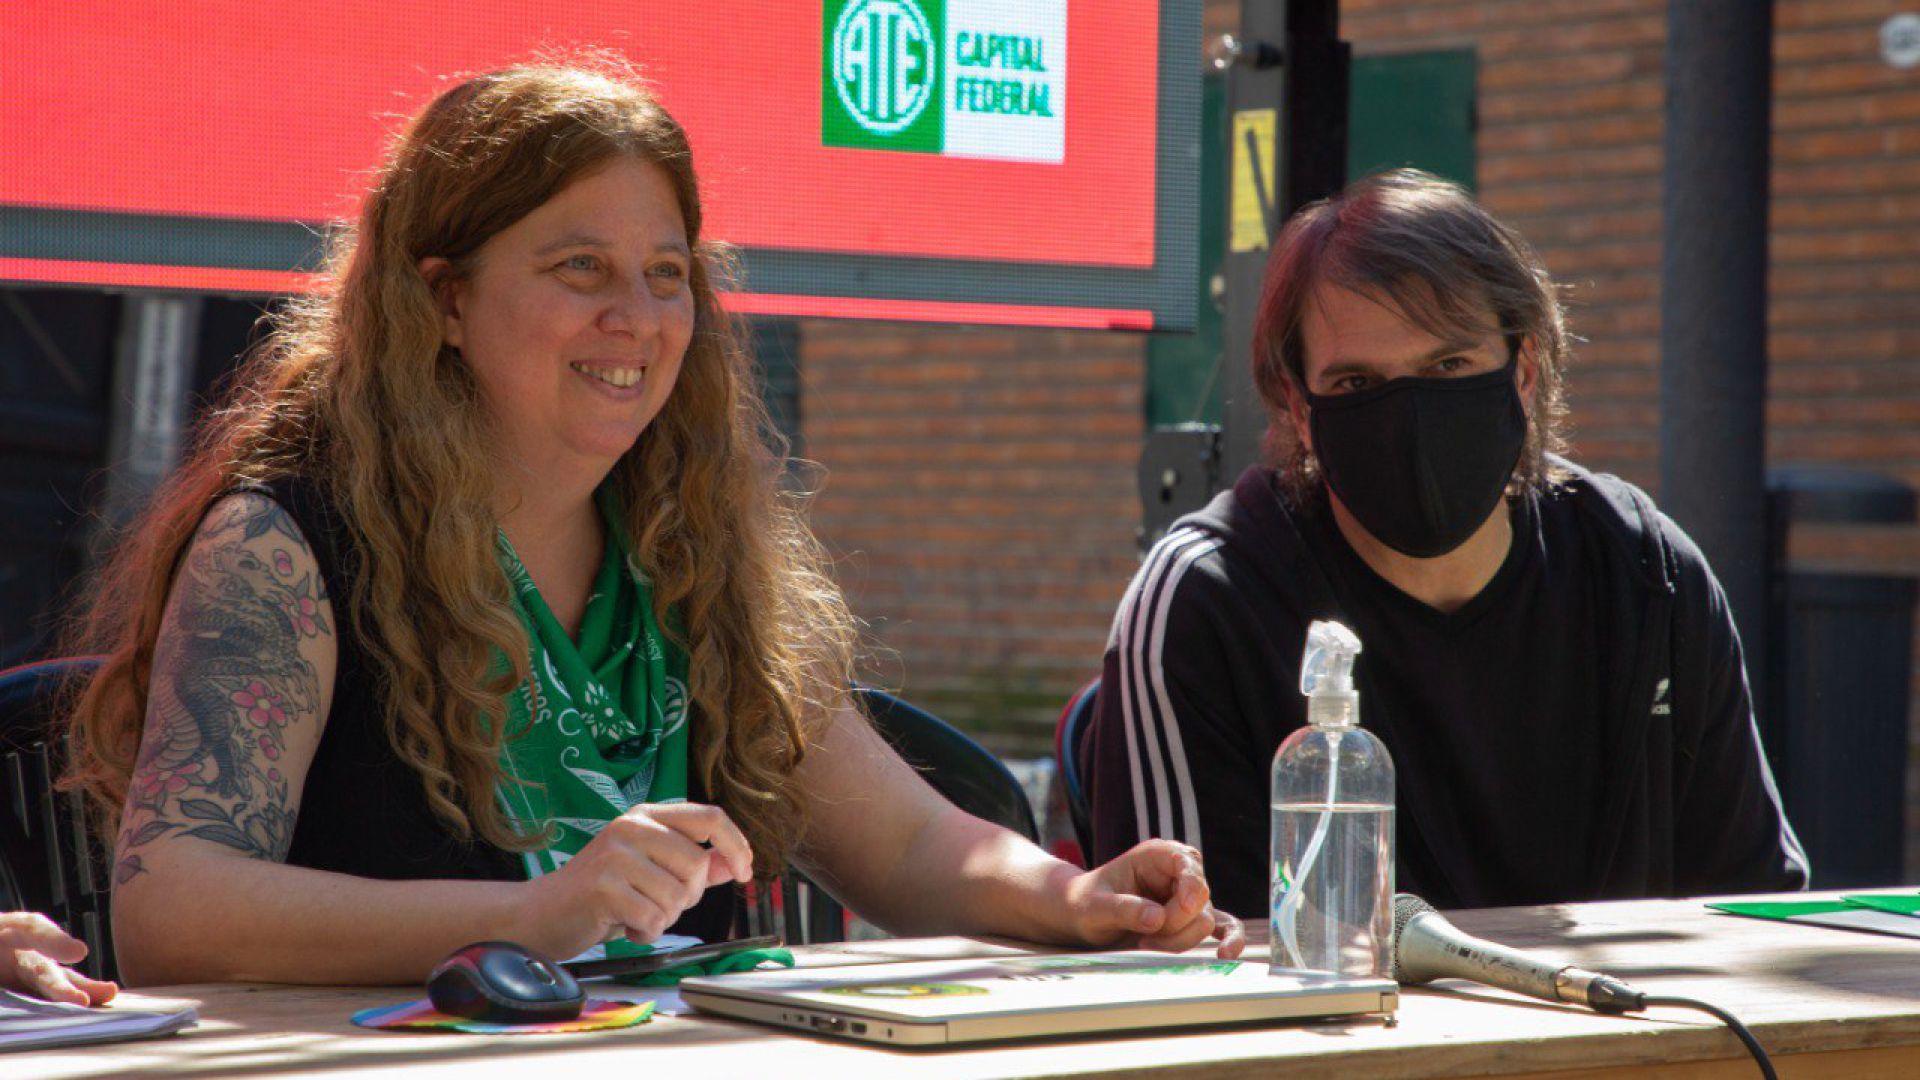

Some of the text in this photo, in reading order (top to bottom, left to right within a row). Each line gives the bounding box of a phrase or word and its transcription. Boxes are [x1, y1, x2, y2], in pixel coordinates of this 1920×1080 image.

[843, 1, 923, 119] ATE
[957, 32, 1046, 71] CAPITAL
[957, 77, 1053, 117] FEDERAL
